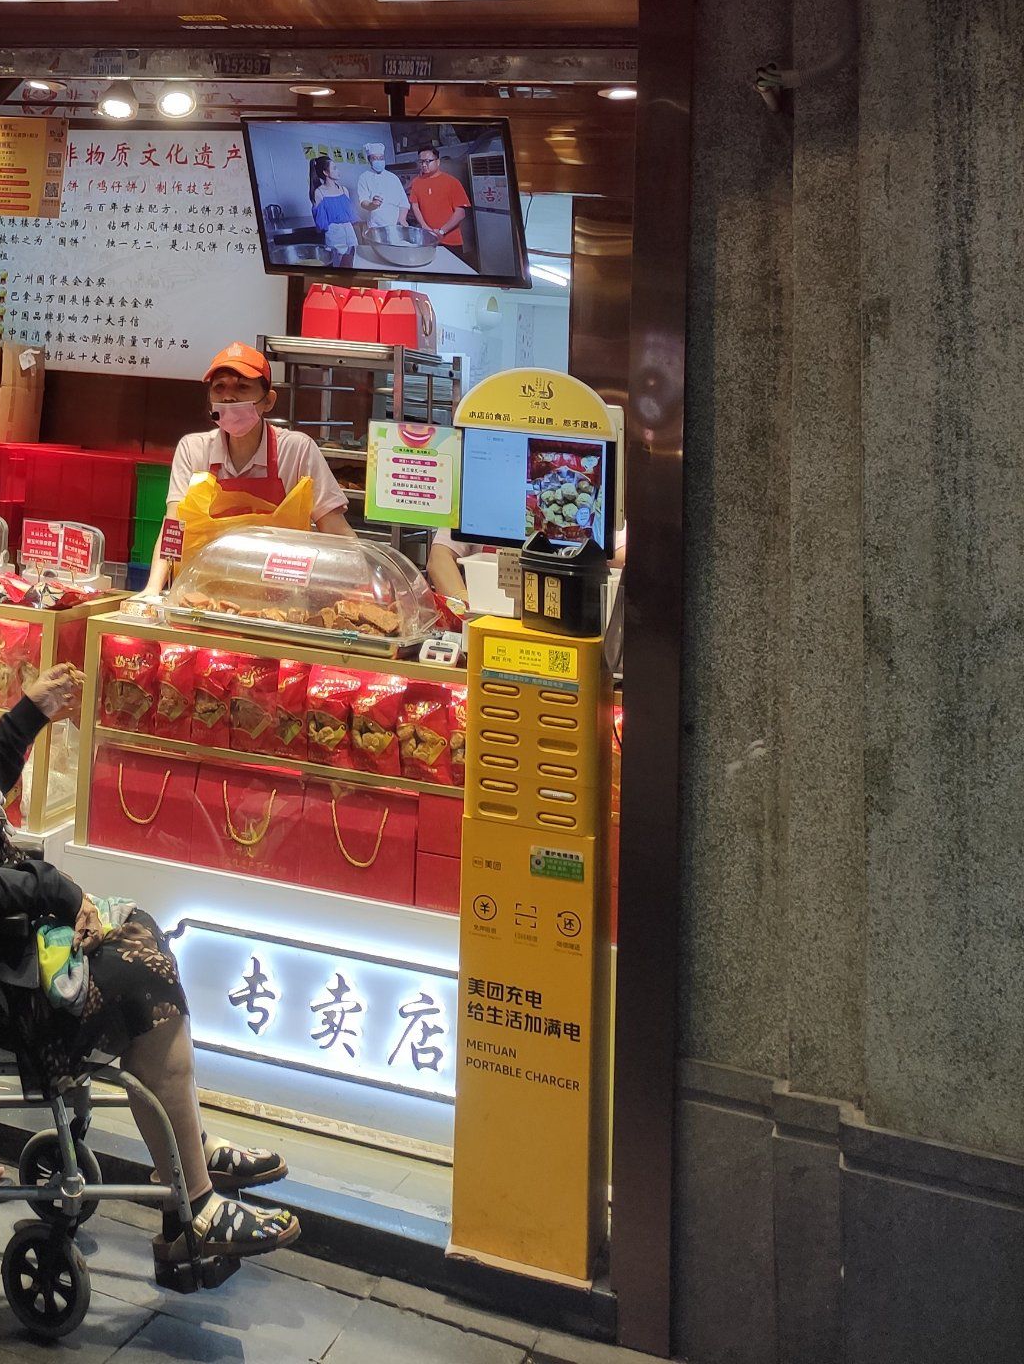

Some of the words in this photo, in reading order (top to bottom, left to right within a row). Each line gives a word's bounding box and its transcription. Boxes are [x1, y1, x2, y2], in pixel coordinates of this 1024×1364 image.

[62, 179, 214, 196] 饼（鸡仔饼）制作技艺
[467, 977, 542, 1010] 美团充电
[227, 955, 446, 1072] 专卖店
[467, 1000, 581, 1043] 给生活加满电
[466, 1038, 517, 1059] MEITUAN
[465, 1056, 522, 1079] PORTABLE
[525, 1070, 580, 1092] CHARGER
